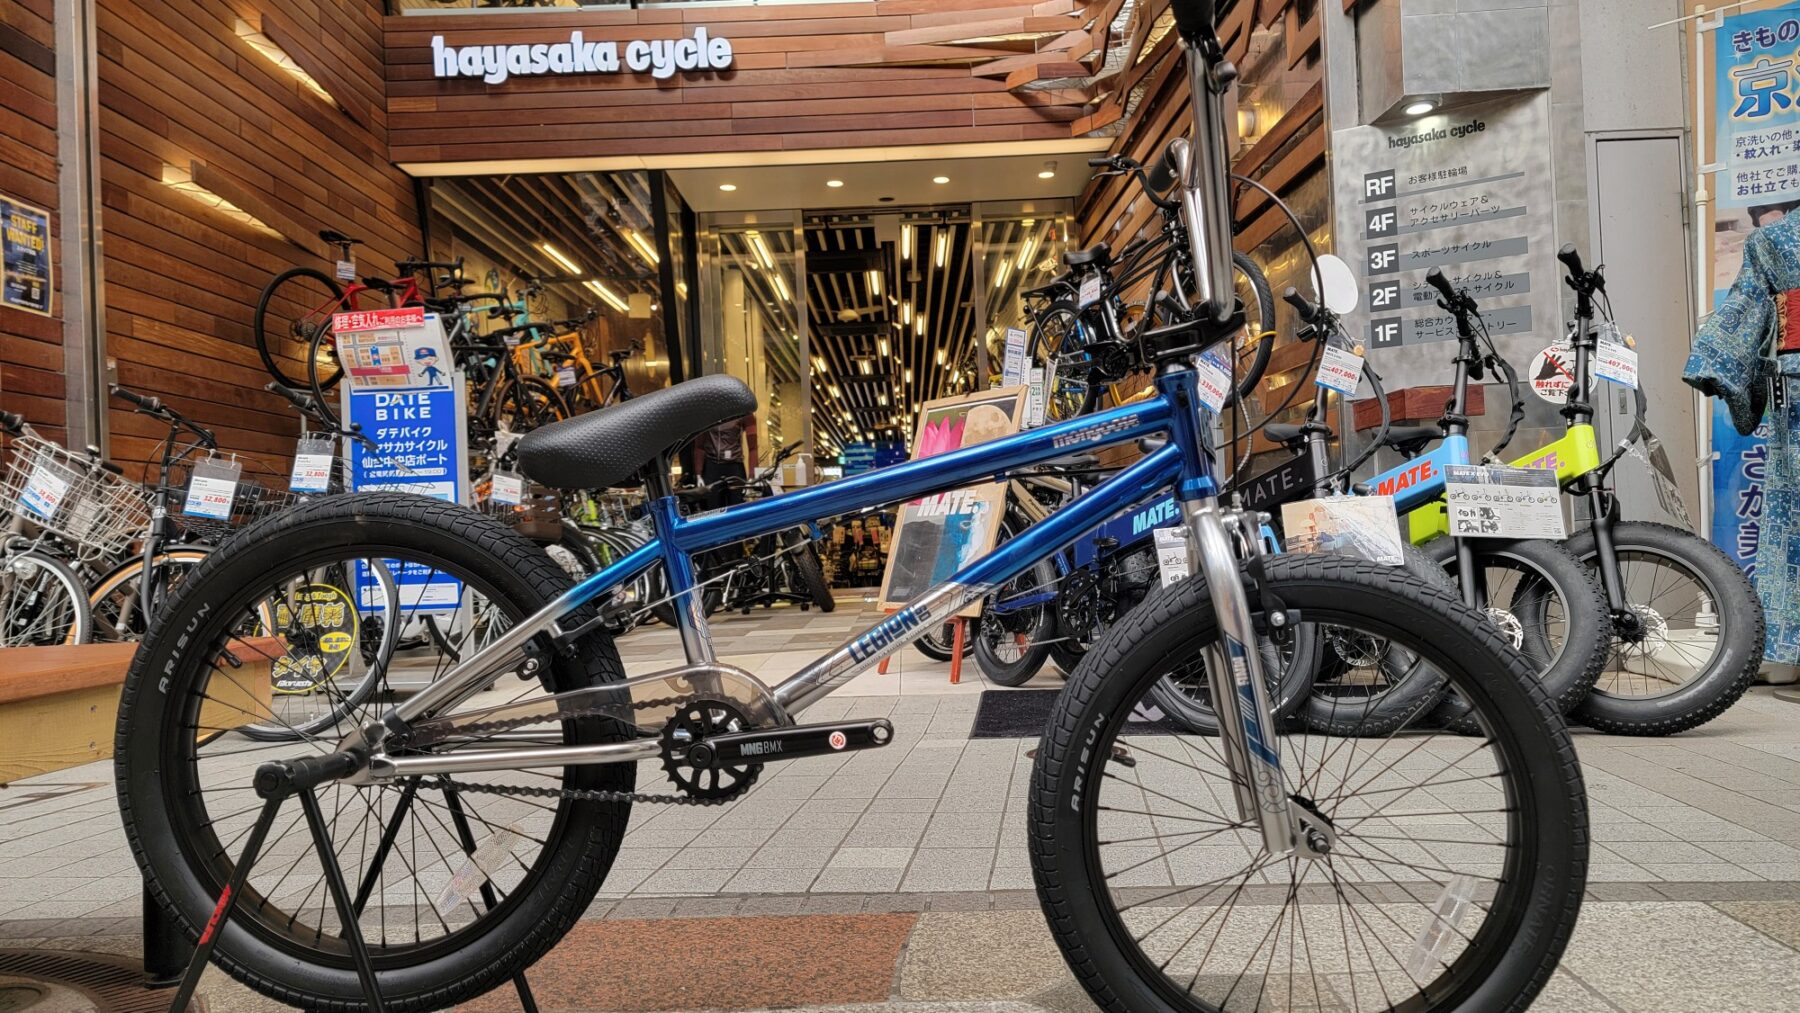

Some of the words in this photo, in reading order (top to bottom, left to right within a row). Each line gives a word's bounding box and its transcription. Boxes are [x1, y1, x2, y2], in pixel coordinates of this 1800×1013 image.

[431, 31, 620, 84] hayasaka
[625, 27, 732, 79] cycle
[1388, 128, 1447, 149] hayasaka
[1450, 119, 1486, 138] cycle
[1408, 166, 1468, 185] お客様駐輪場
[1366, 176, 1393, 197] RF
[1369, 212, 1394, 233] 4F
[1371, 249, 1396, 270] 3F
[1411, 240, 1492, 260] スポーツサイクル
[1372, 286, 1398, 306] 2F
[1413, 281, 1515, 302] 電動アストサイクル
[1374, 323, 1398, 343] 1F
[375, 392, 432, 407] DATE
[375, 407, 432, 421] BIKE
[376, 427, 432, 440] ダテバイク
[1378, 460, 1439, 497] MATE.
[917, 489, 980, 517] MATE.
[1133, 498, 1180, 535] MATE.
[848, 608, 920, 664] LEGION
[159, 603, 210, 695] ARISUN
[1071, 713, 1104, 812] ARISUN
